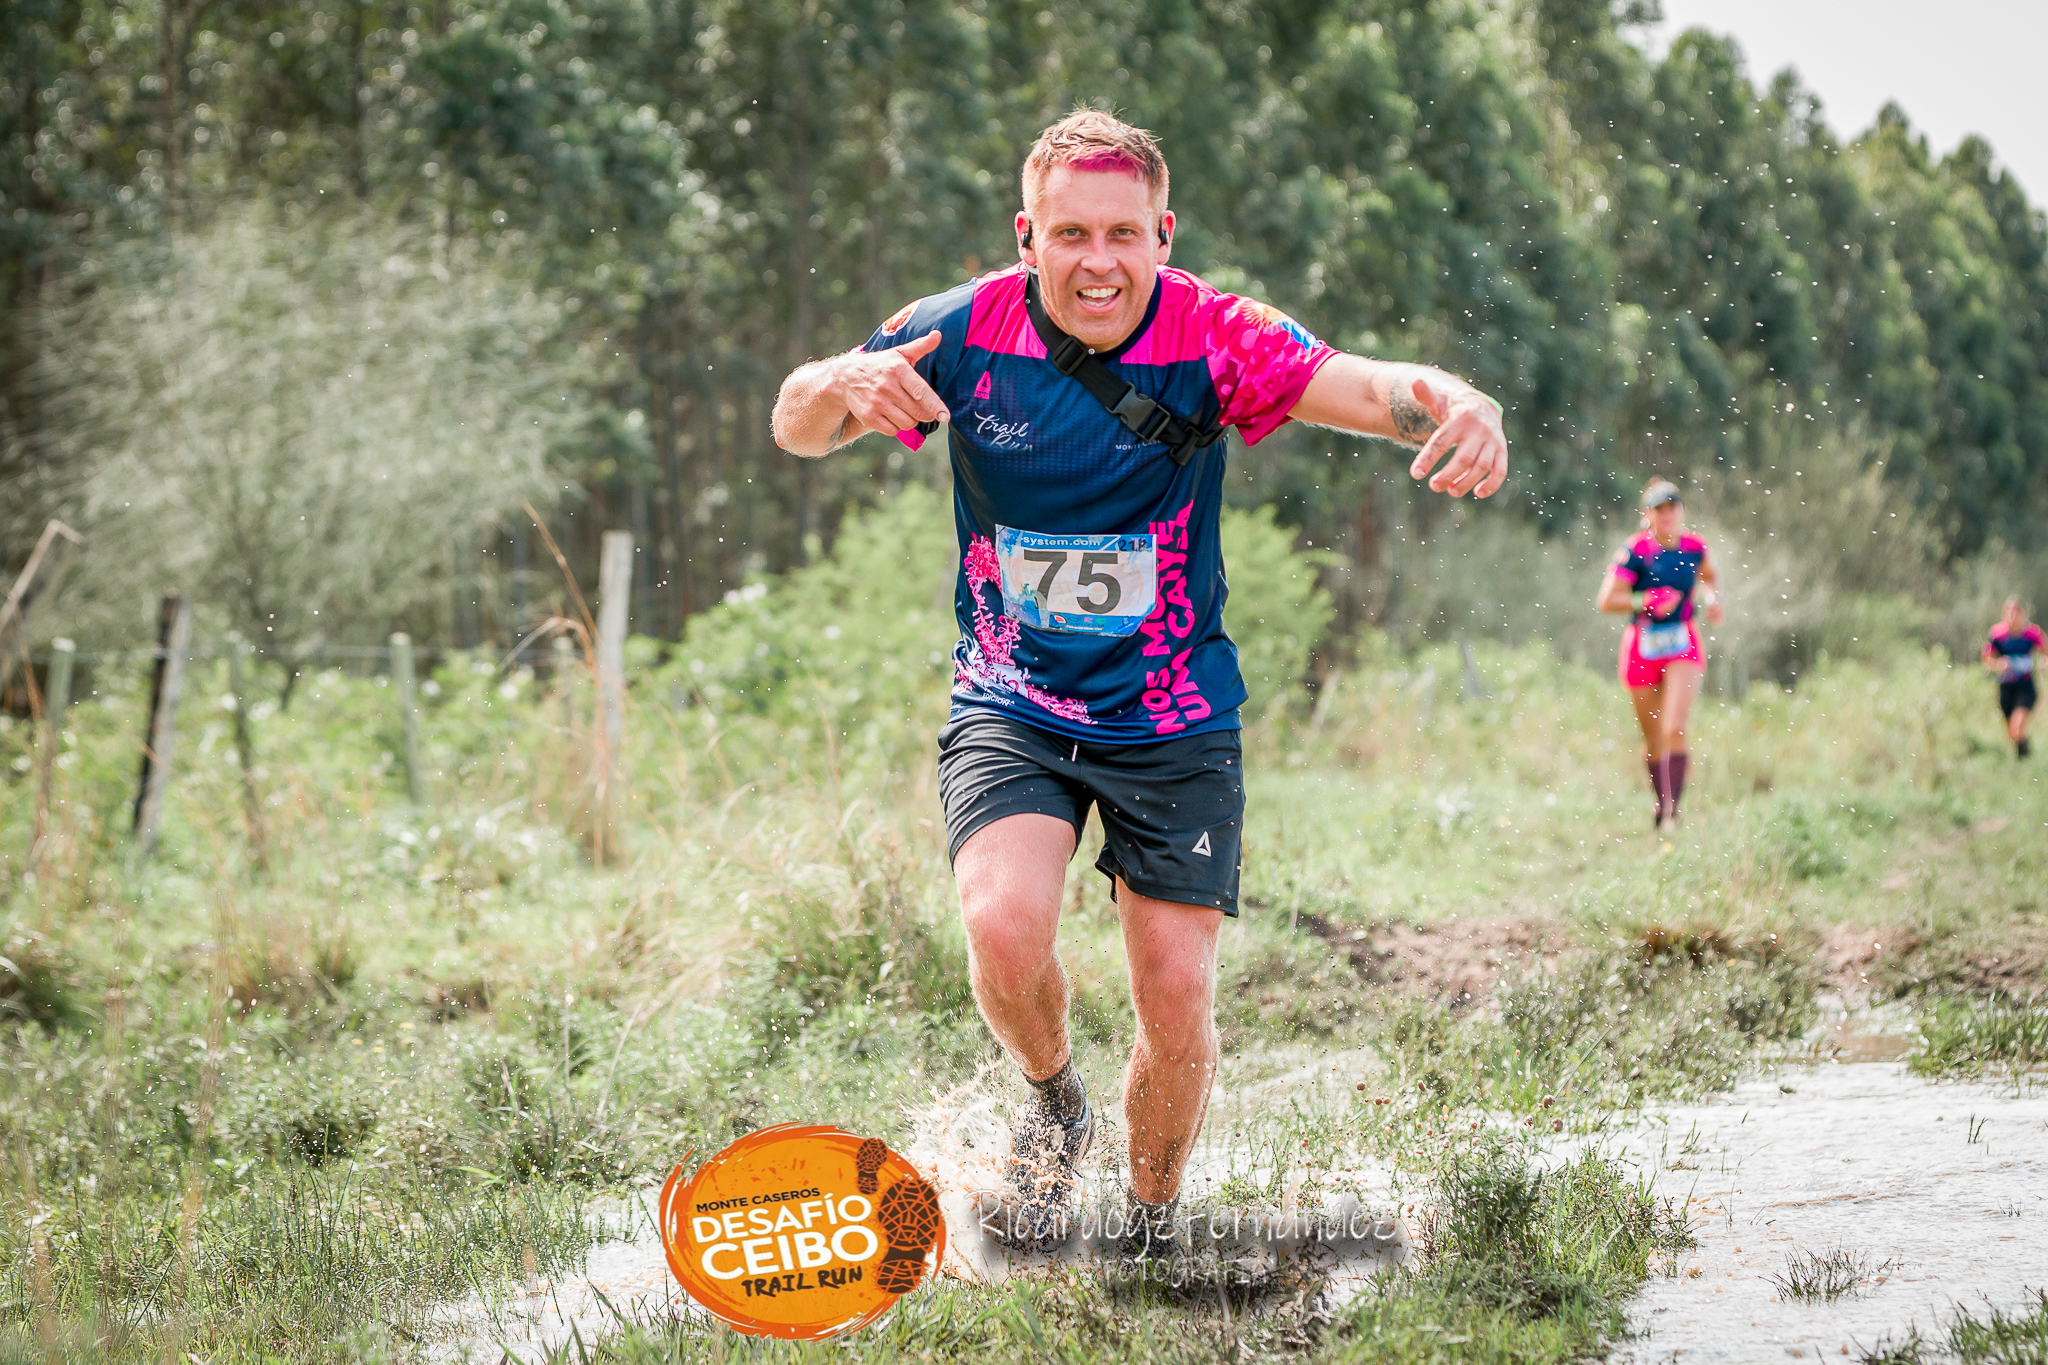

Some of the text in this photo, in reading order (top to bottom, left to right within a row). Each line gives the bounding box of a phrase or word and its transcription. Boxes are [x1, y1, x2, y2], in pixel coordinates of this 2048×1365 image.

[975, 411, 1029, 437] Trail
[987, 432, 1033, 453] Run
[1023, 550, 1121, 614] 75
[1142, 667, 1186, 735] NOS
[1170, 646, 1211, 720] UNA
